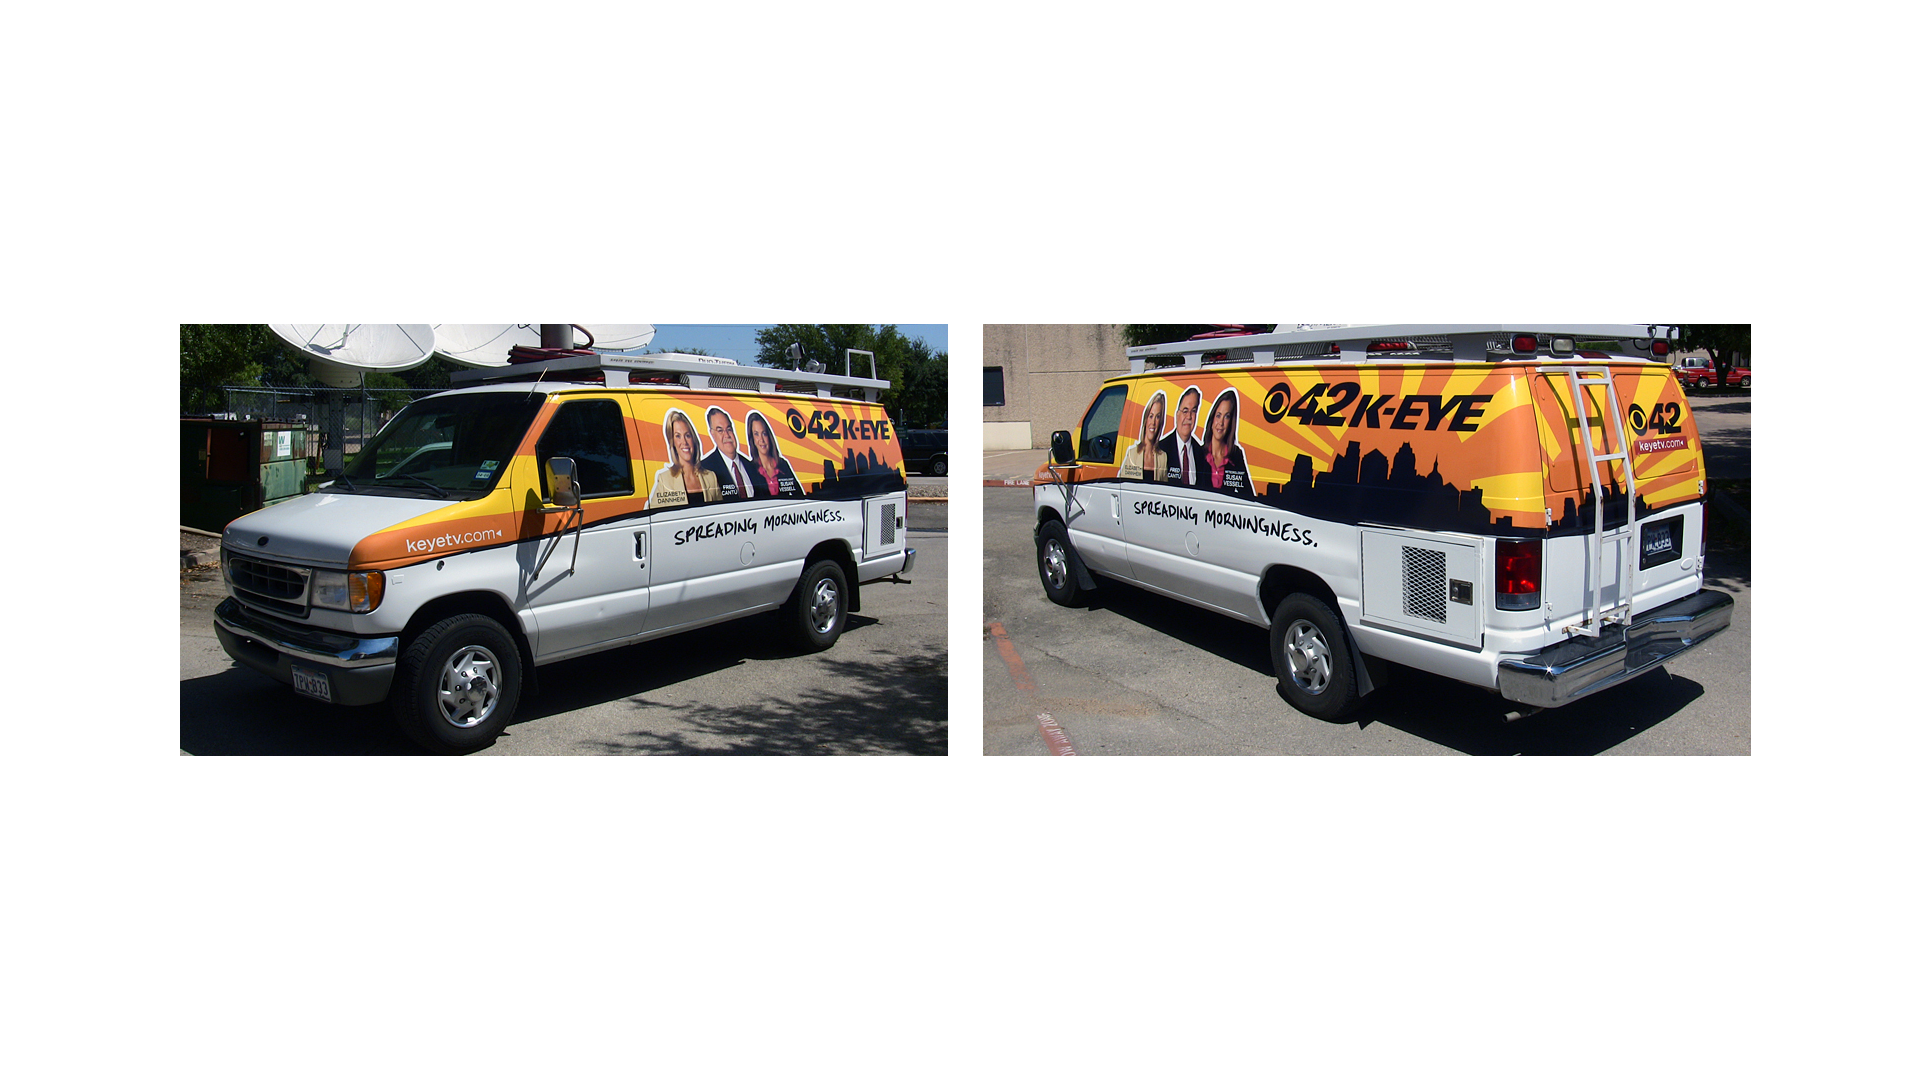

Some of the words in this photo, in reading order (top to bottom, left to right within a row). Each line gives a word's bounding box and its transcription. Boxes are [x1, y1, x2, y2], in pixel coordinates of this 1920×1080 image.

[1287, 381, 1361, 427] 42
[1348, 394, 1494, 432] K-EYE
[1649, 402, 1681, 435] 42
[808, 410, 841, 439] 42
[842, 419, 890, 440] K-EYE
[1638, 439, 1681, 452] keyetv.com
[656, 490, 686, 498] ELIZABETH
[1223, 480, 1245, 488] VESSELL
[674, 518, 757, 545] SPREADING
[763, 509, 845, 531] MORNINGNESS.
[1133, 501, 1198, 525] SPREADING
[1204, 509, 1318, 547] MORNINGNESS.
[406, 529, 496, 553] keyetv.com
